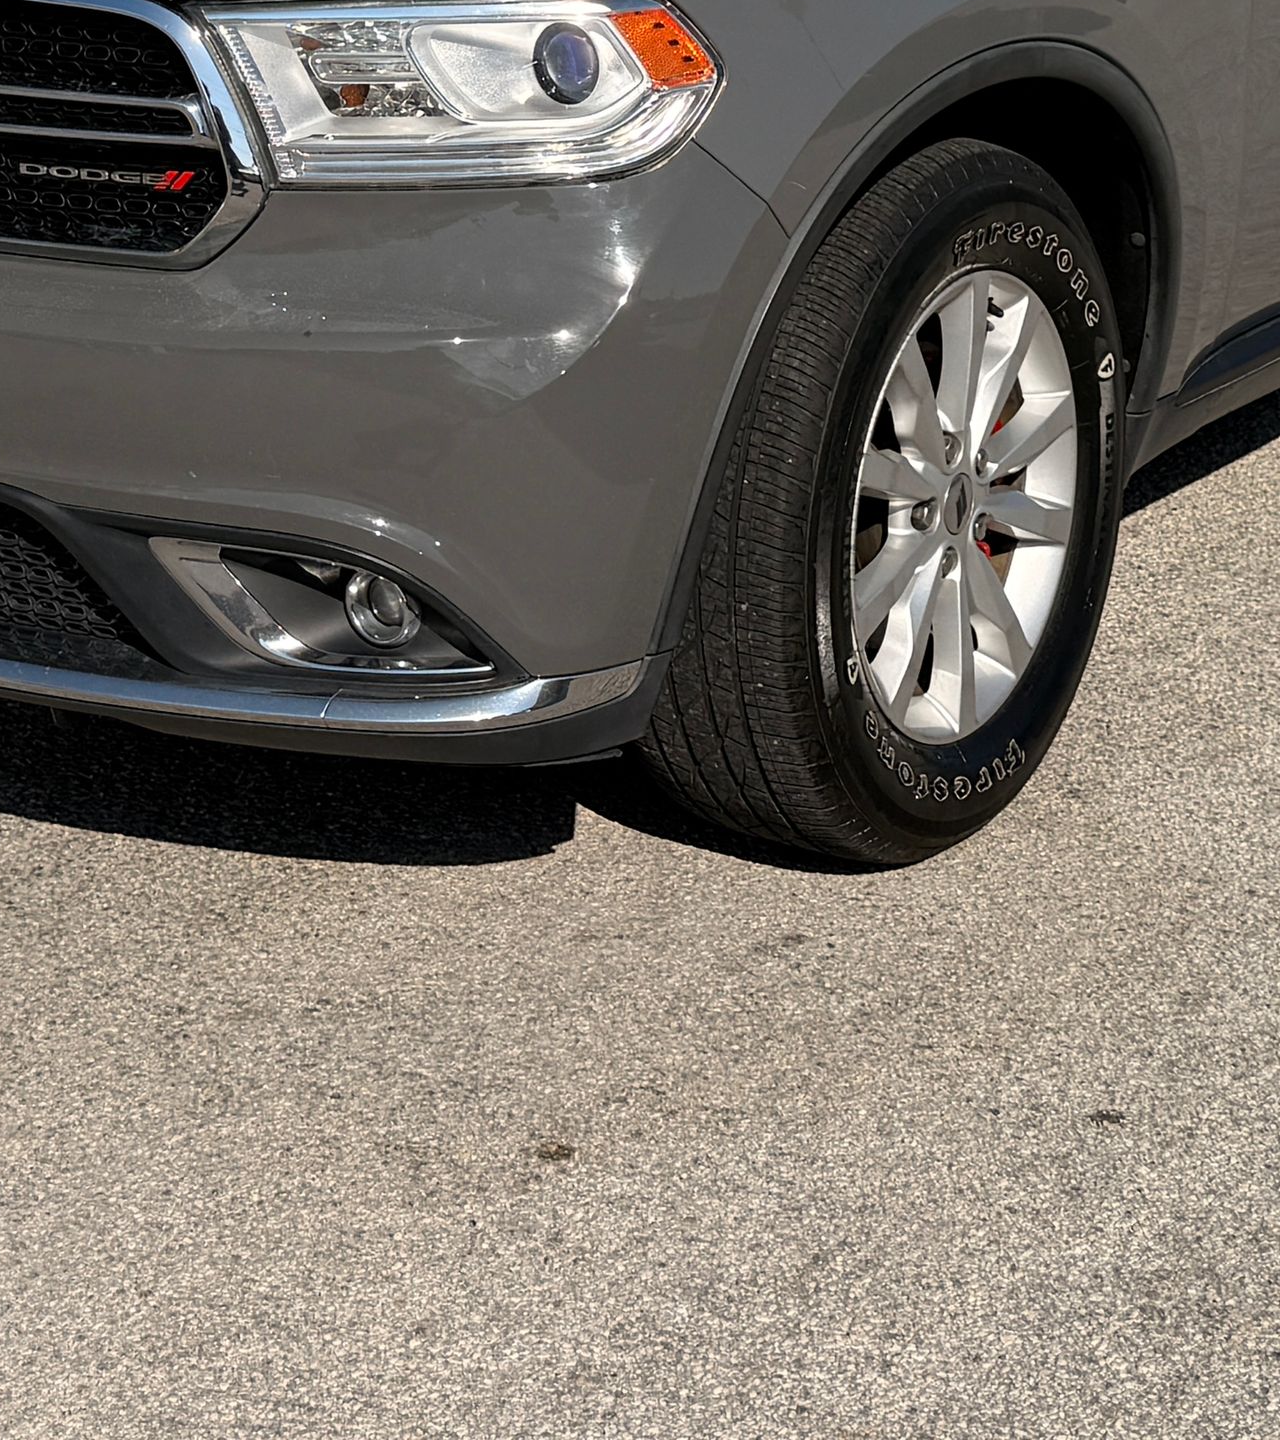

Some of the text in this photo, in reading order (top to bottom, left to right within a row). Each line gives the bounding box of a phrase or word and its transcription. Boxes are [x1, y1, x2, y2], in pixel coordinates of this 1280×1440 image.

[19, 162, 170, 186] DODGE
[954, 221, 1100, 327] Firestone
[865, 710, 1026, 802] Firestone
